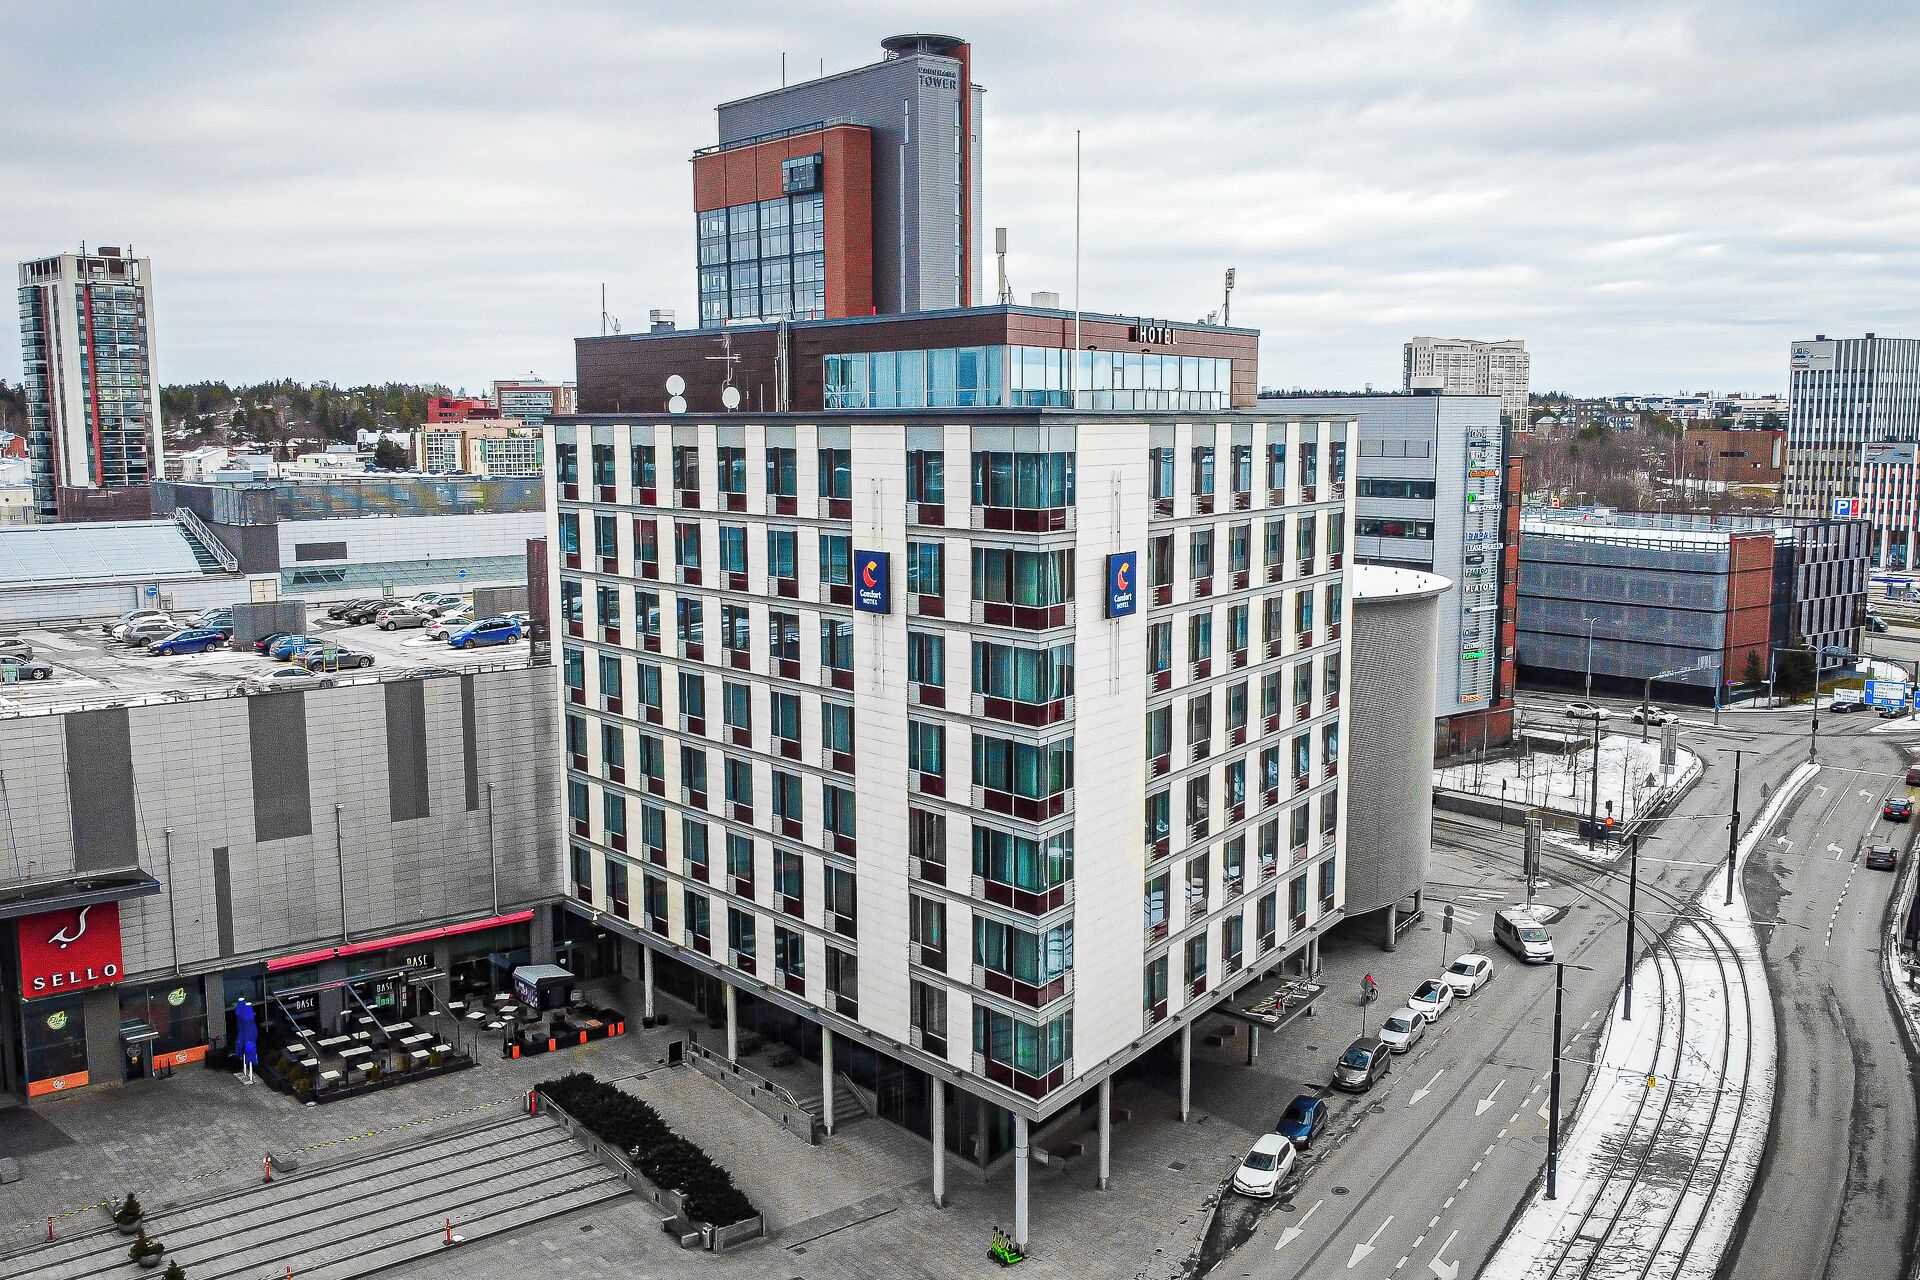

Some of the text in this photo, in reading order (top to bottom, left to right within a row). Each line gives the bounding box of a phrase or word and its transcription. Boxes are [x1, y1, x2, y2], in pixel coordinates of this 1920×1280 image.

[919, 75, 956, 90] TOWER
[1139, 326, 1178, 345] HOTEL
[1837, 500, 1848, 514] P
[860, 589, 881, 600] Comfort
[1114, 593, 1132, 603] Comfort
[1116, 602, 1129, 610] HOTEL
[33, 964, 117, 990] SELLO
[377, 982, 394, 993] BASE
[296, 998, 314, 1010] BASE
